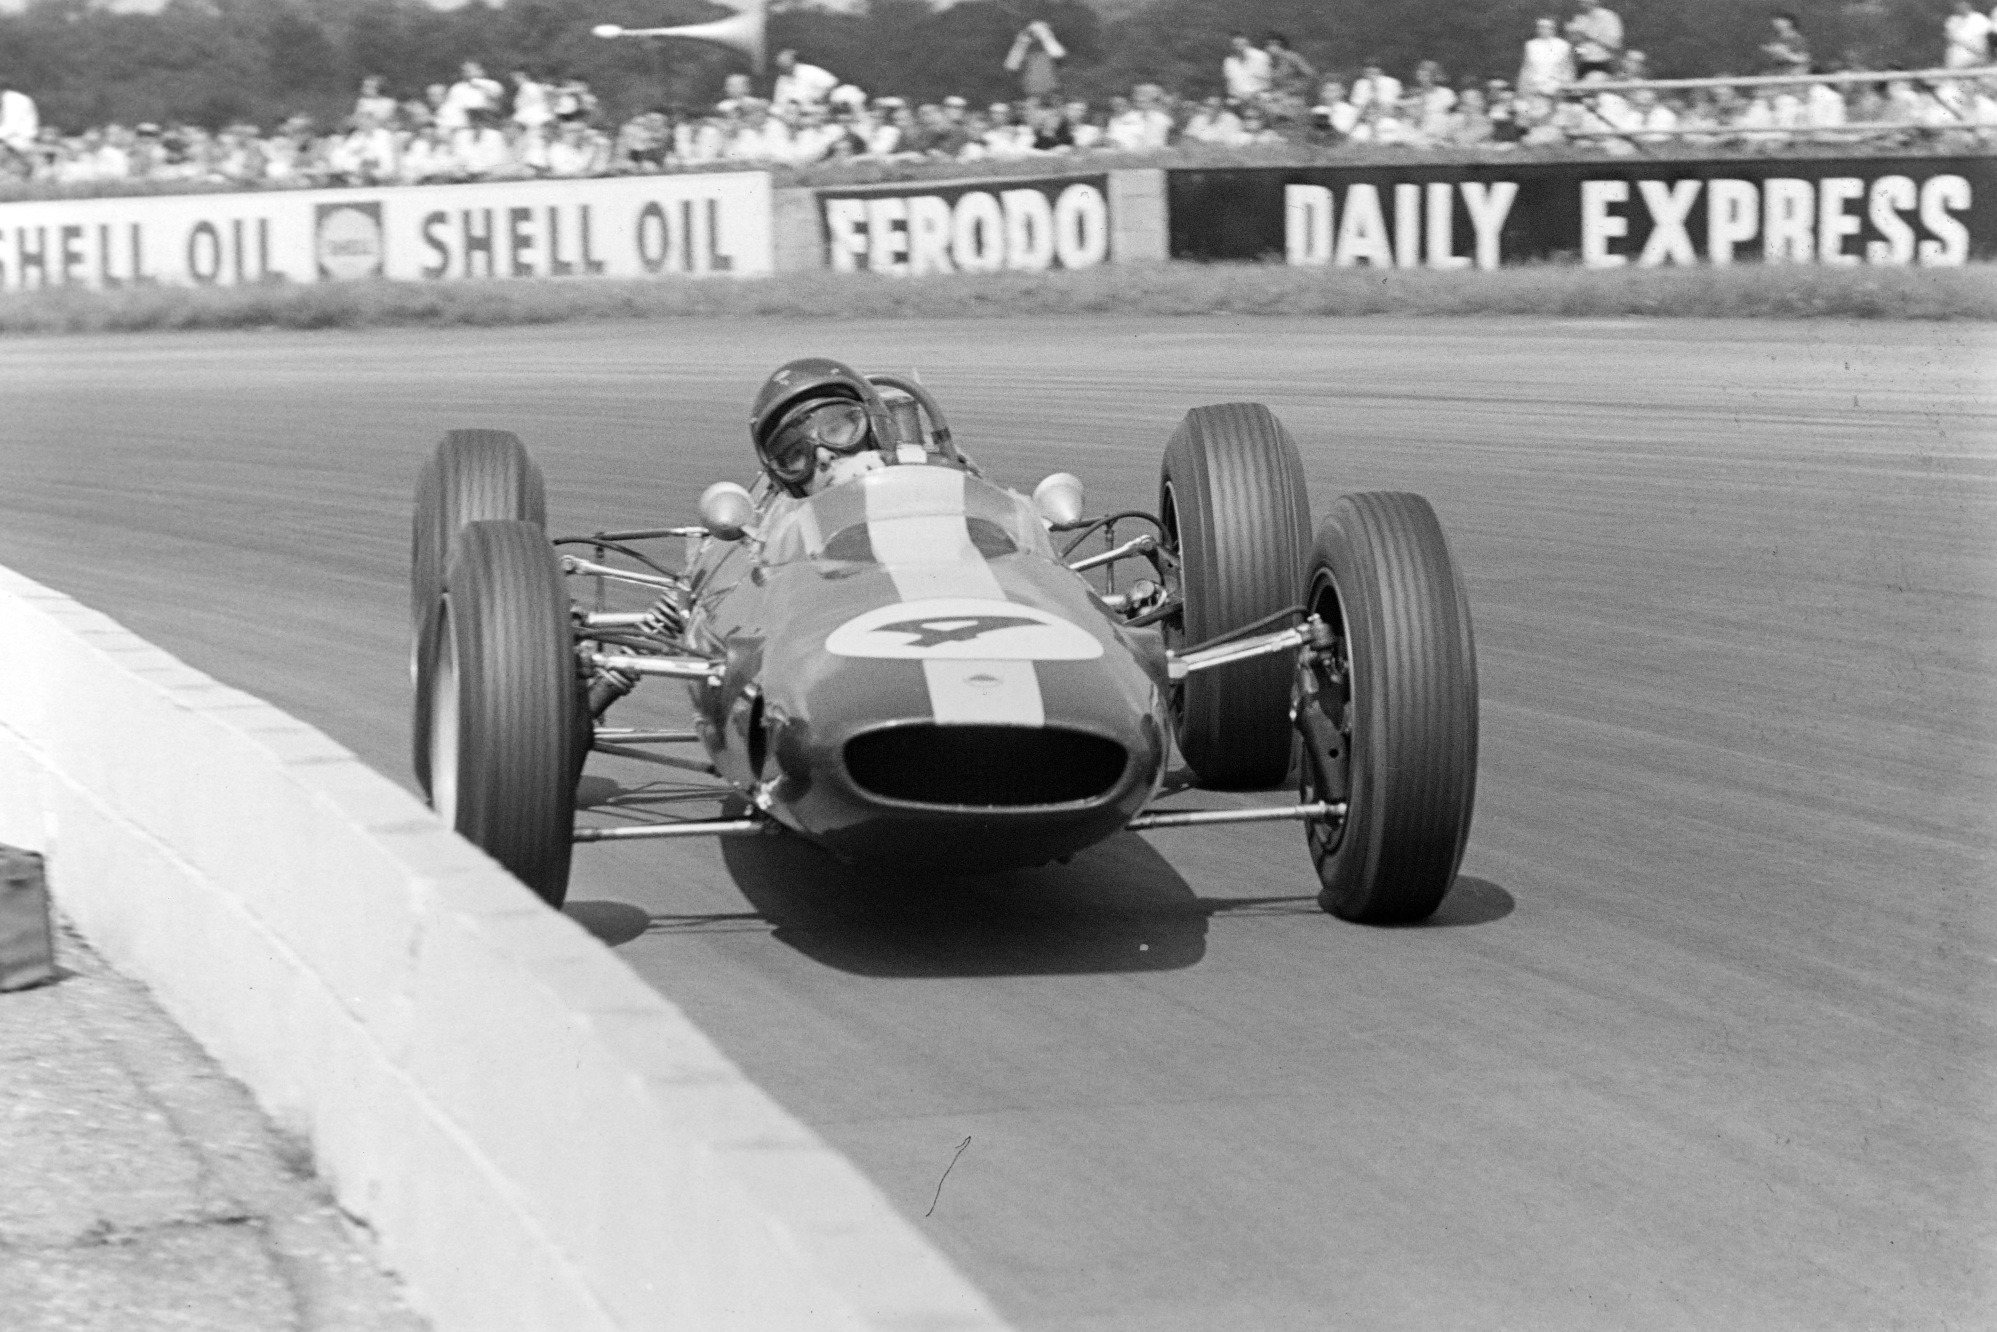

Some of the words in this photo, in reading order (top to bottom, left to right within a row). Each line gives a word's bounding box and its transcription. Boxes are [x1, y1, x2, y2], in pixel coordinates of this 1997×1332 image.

[0, 223, 157, 289] HELL
[188, 218, 290, 287] OIL
[421, 205, 605, 279] SHELL
[637, 199, 734, 273] OIL
[826, 183, 1108, 276] FERODO
[1284, 181, 1519, 271] DAILY
[1580, 174, 1972, 270] EXPRESS
